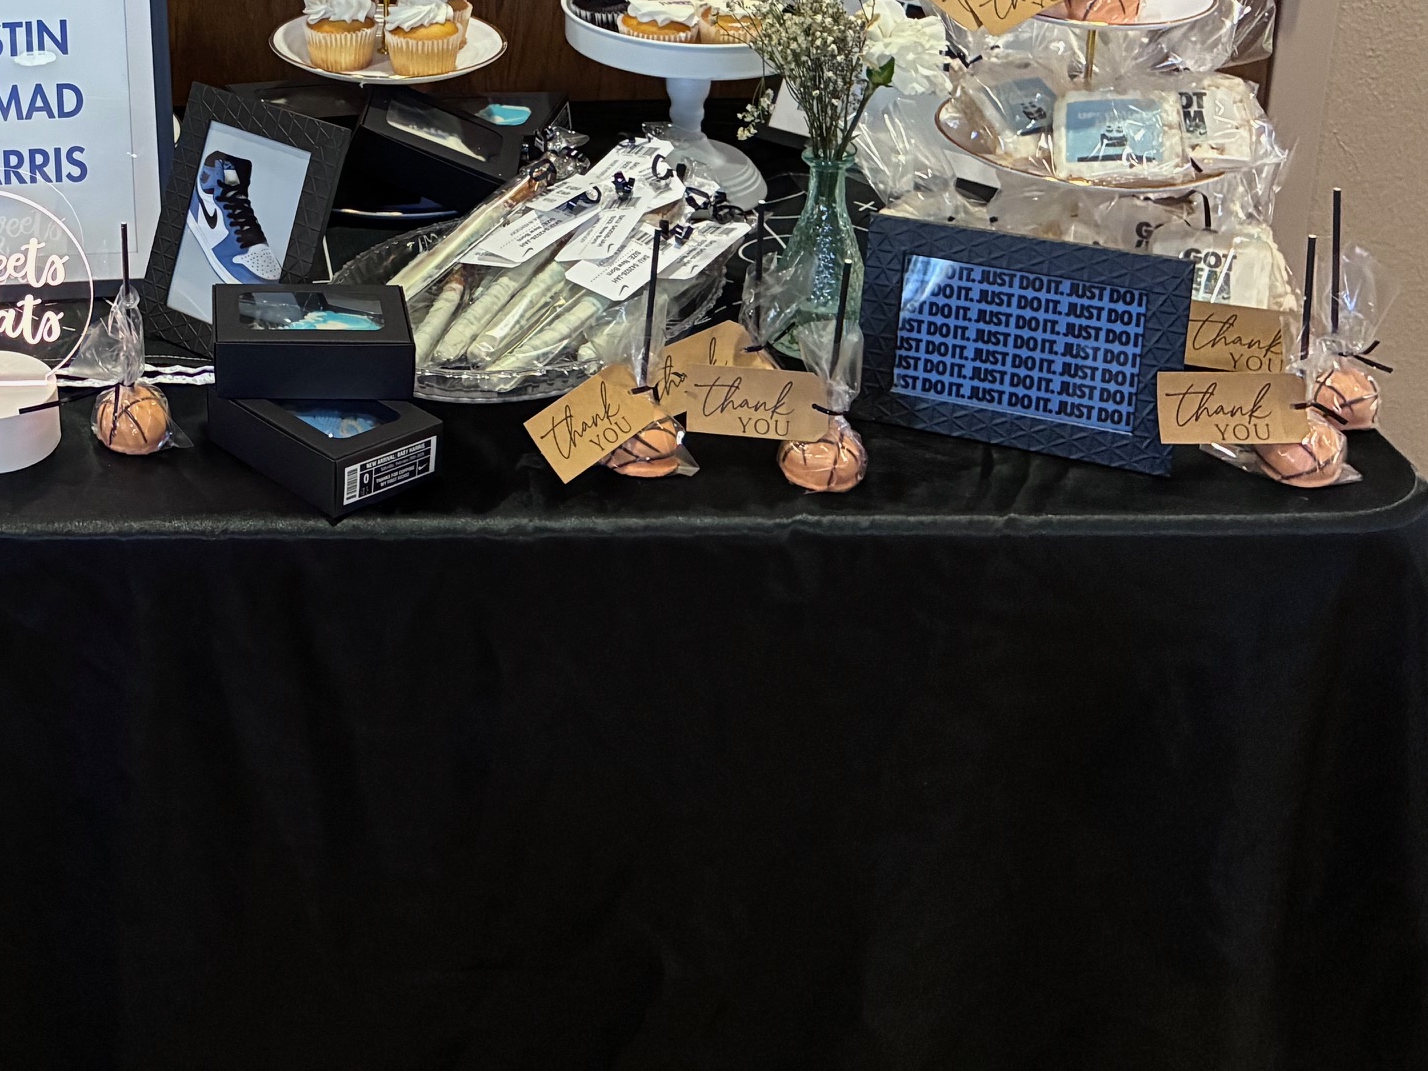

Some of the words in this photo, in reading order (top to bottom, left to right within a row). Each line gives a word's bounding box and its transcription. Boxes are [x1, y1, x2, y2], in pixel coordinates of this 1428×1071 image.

[606, 267, 620, 277] Born
[958, 266, 976, 283] IT.
[977, 269, 1017, 288] JUST
[1019, 274, 1044, 292] DO
[1045, 278, 1064, 296] IT.
[1066, 281, 1107, 302] JUST
[1109, 287, 1136, 306] DO
[928, 301, 953, 319] DO
[954, 305, 973, 323] IT.
[974, 308, 1013, 328] JUST
[1014, 314, 1040, 332] DO
[1042, 318, 1061, 336] IT.
[1062, 322, 1103, 342] JUST
[1104, 328, 1132, 346] DO
[930, 283, 955, 299] DO
[956, 286, 975, 303] IT.
[976, 288, 1015, 308] JUST
[1017, 294, 1042, 312] DO
[1043, 298, 1063, 316] IT.
[1064, 301, 1105, 322] JUST
[1106, 307, 1134, 326] DO
[926, 320, 951, 338] DO
[953, 325, 971, 342] IT.
[972, 328, 1011, 348] JUST
[1013, 334, 1039, 352] DO
[1040, 338, 1059, 356] IT.
[1060, 342, 1101, 362] JUST
[1103, 348, 1129, 367] DO
[1189, 313, 1282, 358] thank
[923, 358, 947, 376] DO
[949, 362, 967, 380] IT.
[969, 366, 1007, 386] JUST
[1009, 372, 1035, 390] DO
[1036, 376, 1055, 394] IT.
[1057, 381, 1097, 401] JUST
[1099, 387, 1125, 405] DO
[925, 340, 949, 357] DO
[951, 344, 969, 361] IT.
[971, 347, 1009, 367] JUST
[1011, 353, 1037, 371] DO
[1038, 357, 1057, 375] IT.
[1058, 361, 1099, 382] JUST
[1101, 368, 1127, 386] DO
[1229, 353, 1283, 373] YOU
[694, 376, 794, 419] thank
[921, 377, 946, 395] DO
[947, 381, 966, 399] IT.
[967, 385, 1006, 405] JUST
[1007, 391, 1033, 409] DO
[1034, 396, 1053, 414] IT.
[1055, 400, 1095, 420] JUST
[1097, 407, 1123, 425] DO
[1165, 382, 1272, 427] thank
[540, 381, 621, 459] thank
[589, 416, 632, 451] YOU
[738, 416, 790, 437] YOU
[1214, 423, 1271, 441] YOU
[363, 473, 369, 484] 0
